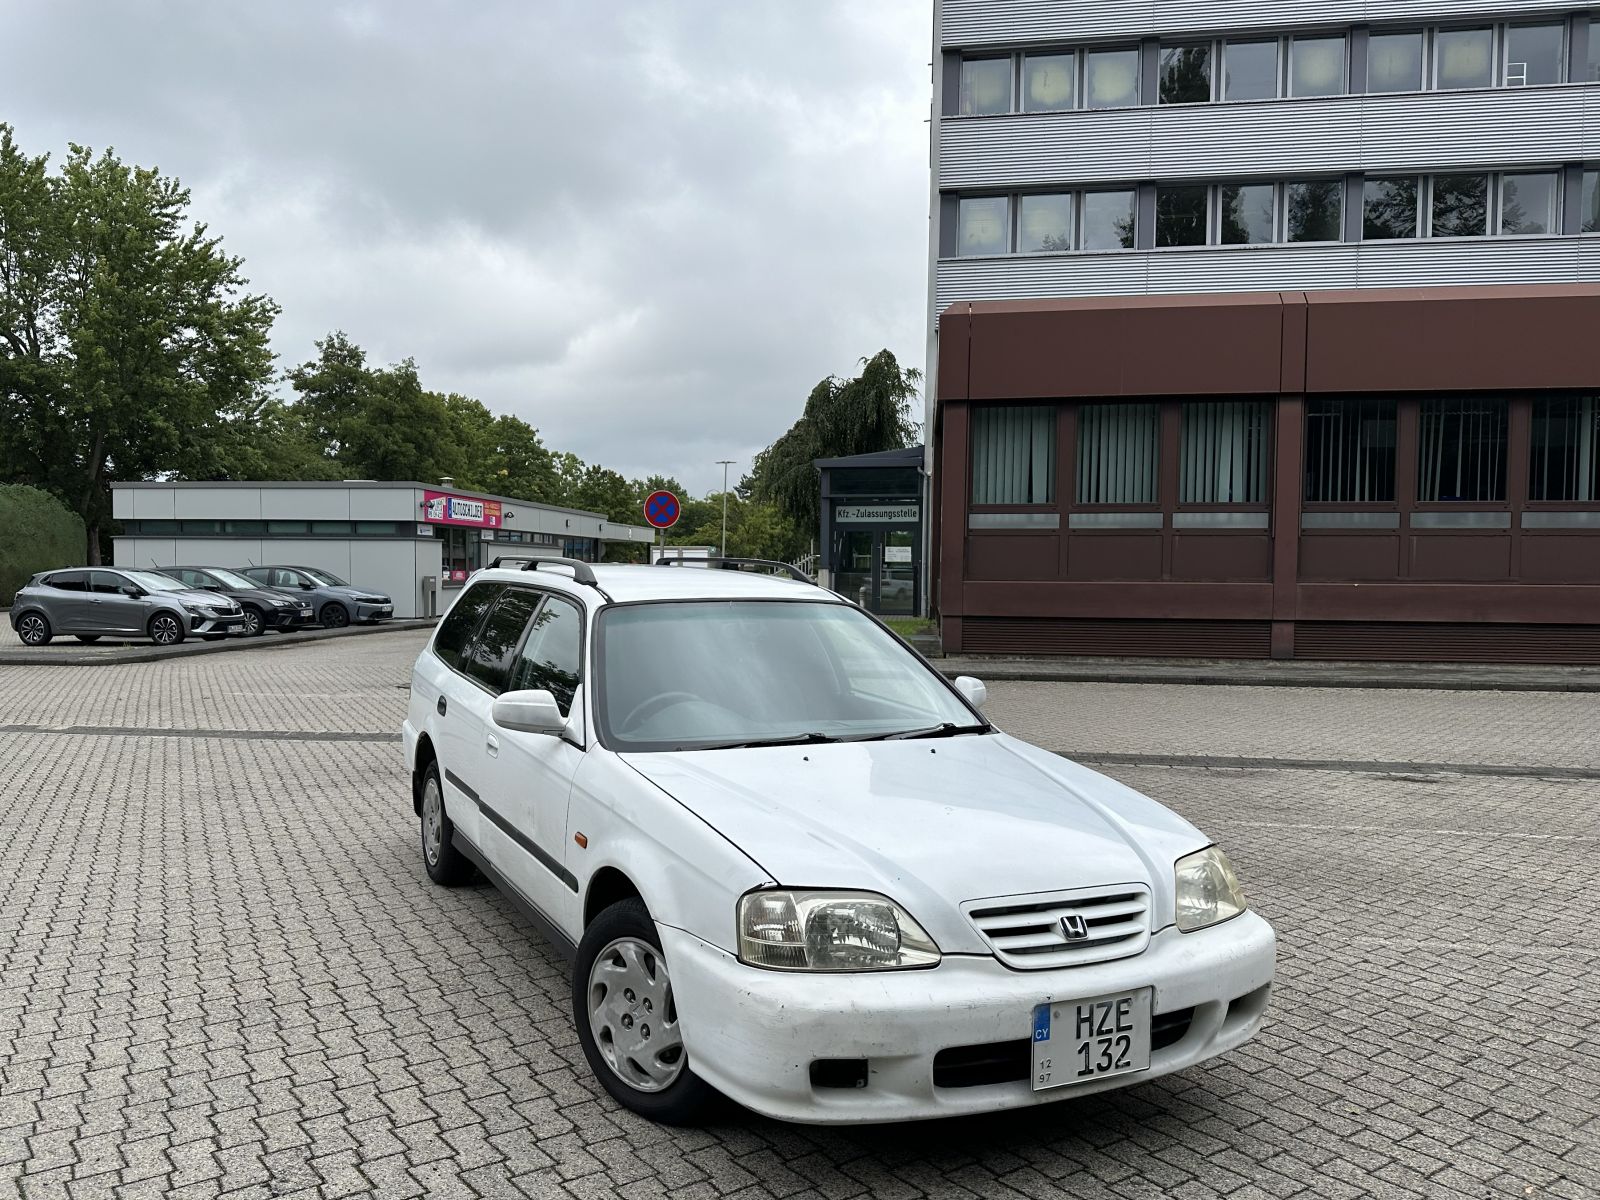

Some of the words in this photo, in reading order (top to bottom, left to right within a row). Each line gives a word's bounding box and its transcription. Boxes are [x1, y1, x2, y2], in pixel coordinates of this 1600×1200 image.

[837, 509, 917, 519] Kfz.-Zulassungsstelle
[1076, 997, 1133, 1039] HZE
[1035, 1028, 1049, 1039] CY
[1077, 1034, 1131, 1076] 132
[1040, 1059, 1052, 1069] 12
[1039, 1073, 1051, 1083] 97
